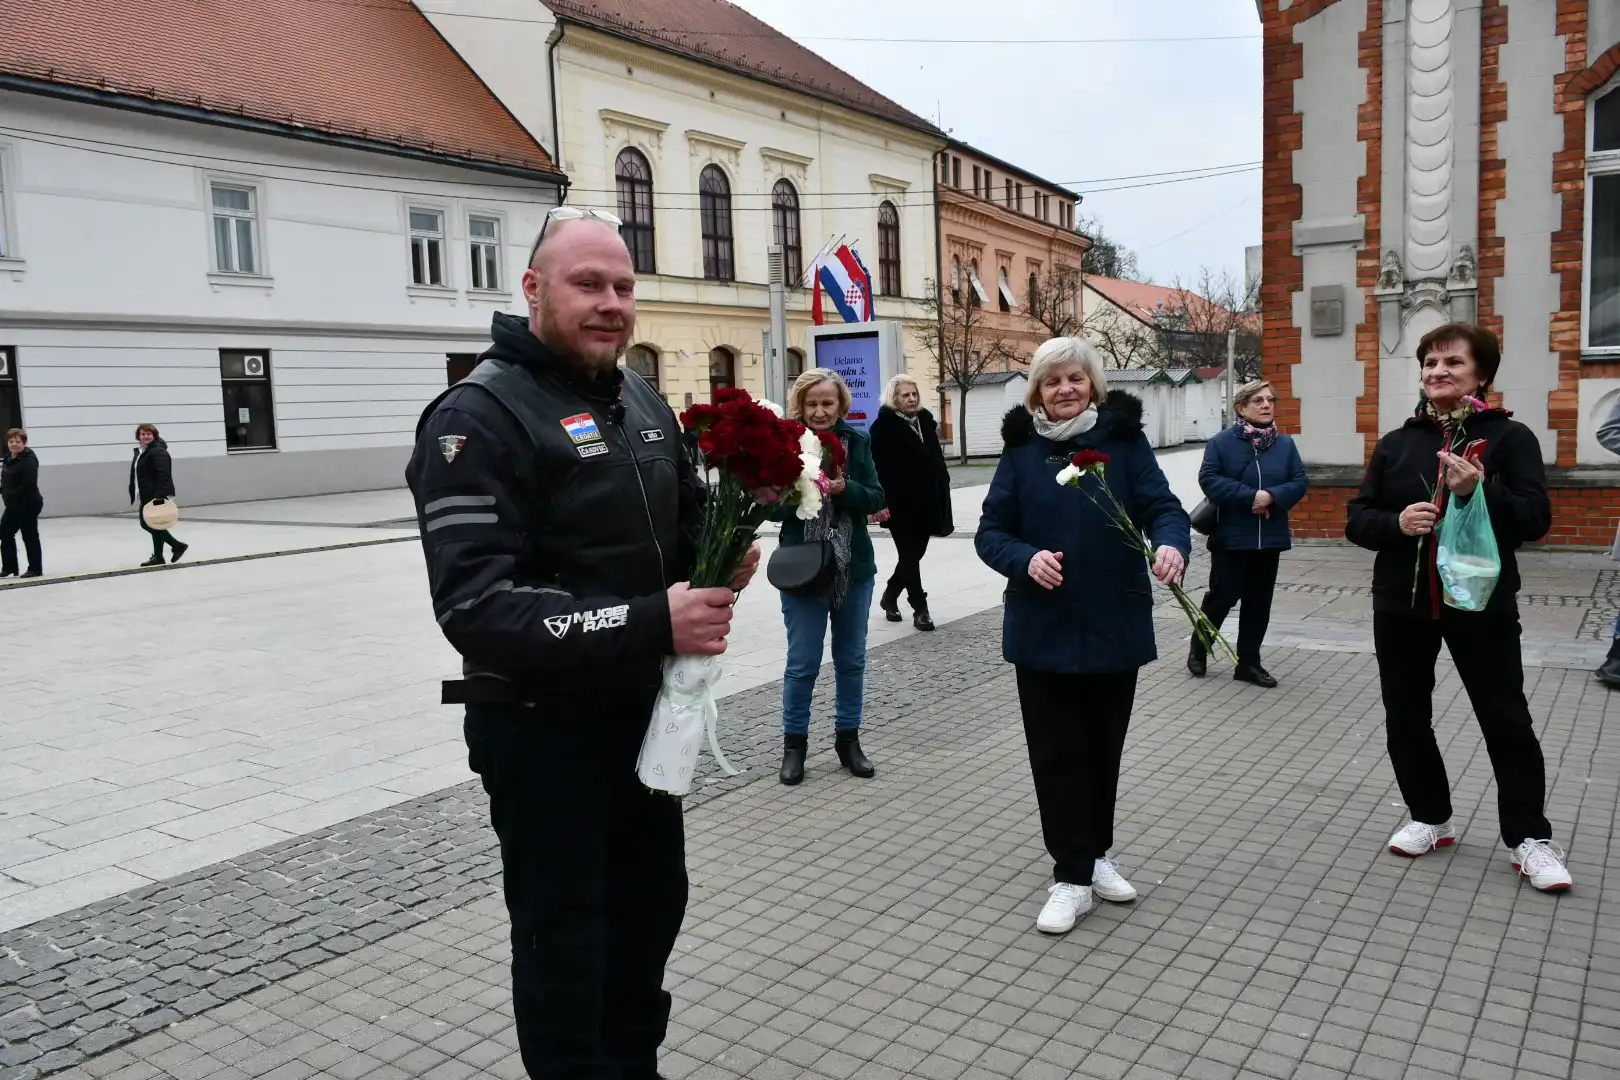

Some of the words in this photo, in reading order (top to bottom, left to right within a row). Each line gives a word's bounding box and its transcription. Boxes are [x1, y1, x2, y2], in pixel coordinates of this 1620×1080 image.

[834, 356, 863, 365] Delamo
[858, 366, 867, 375] 3.
[582, 614, 628, 633] RACE
